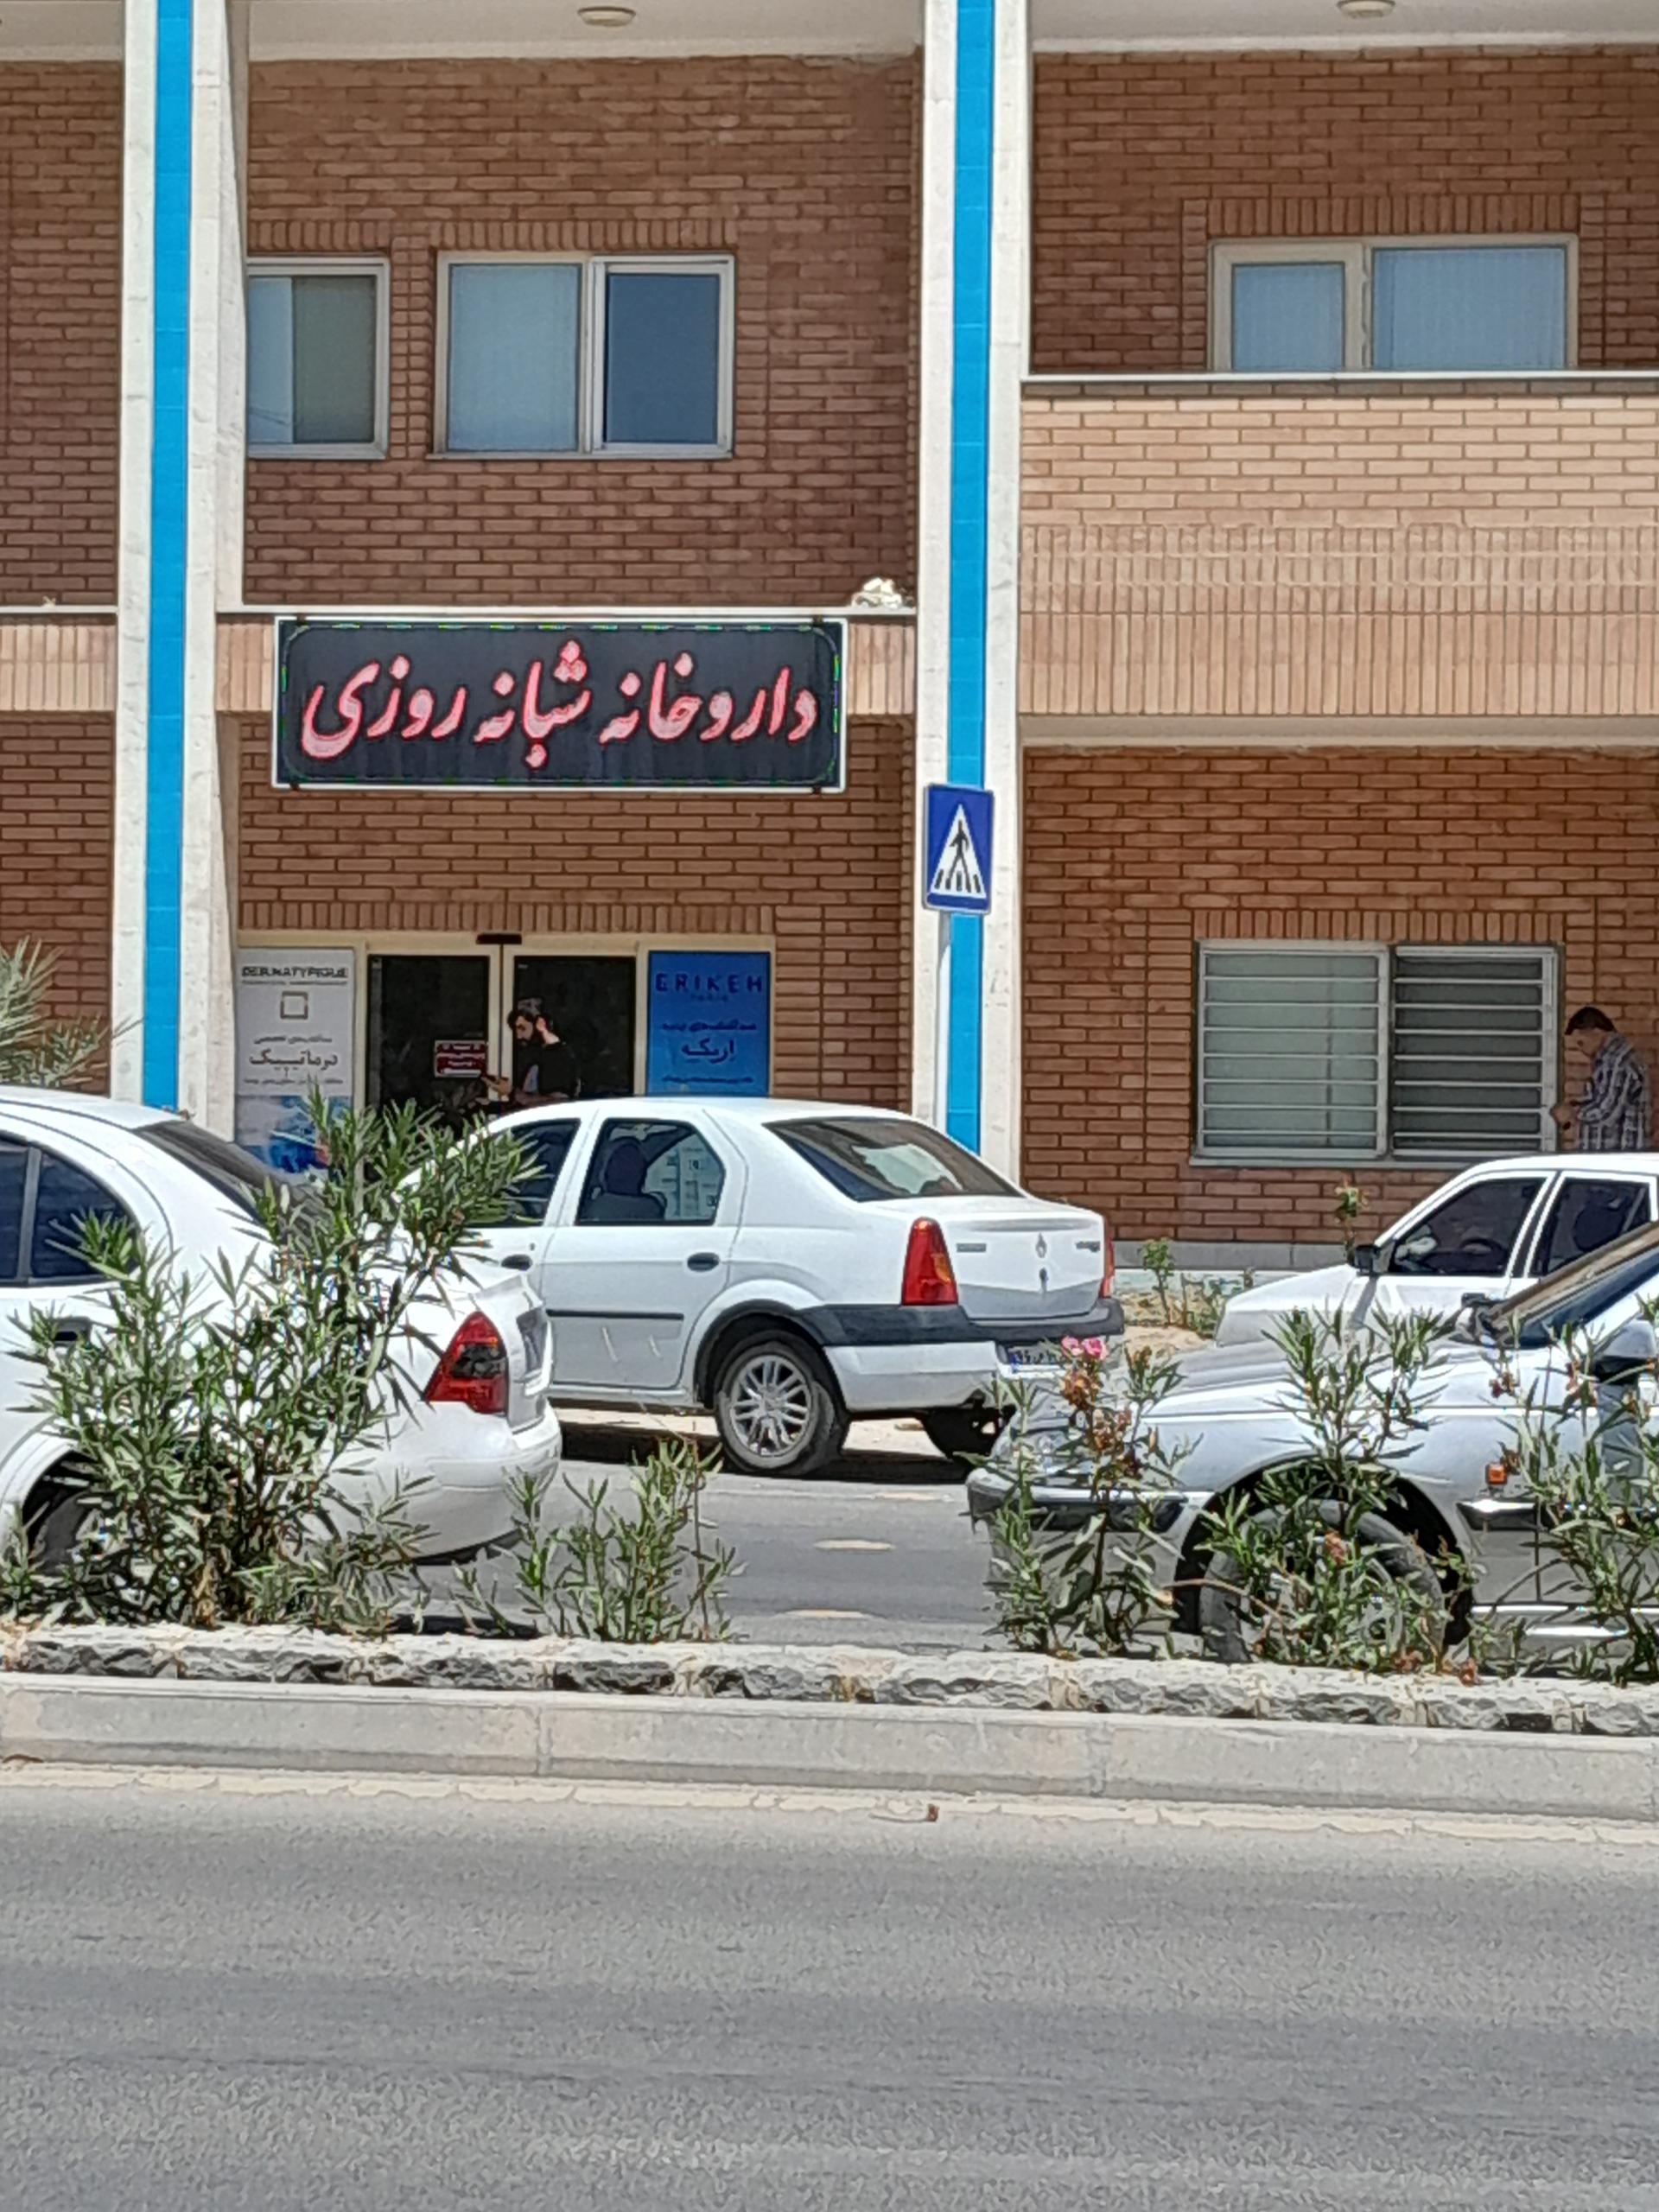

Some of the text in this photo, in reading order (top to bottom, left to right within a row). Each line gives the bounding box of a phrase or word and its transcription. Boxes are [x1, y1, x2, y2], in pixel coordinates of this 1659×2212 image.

[301, 639, 817, 770] داروخانه شبانه روزی
[655, 973, 762, 993] ERIKEH
